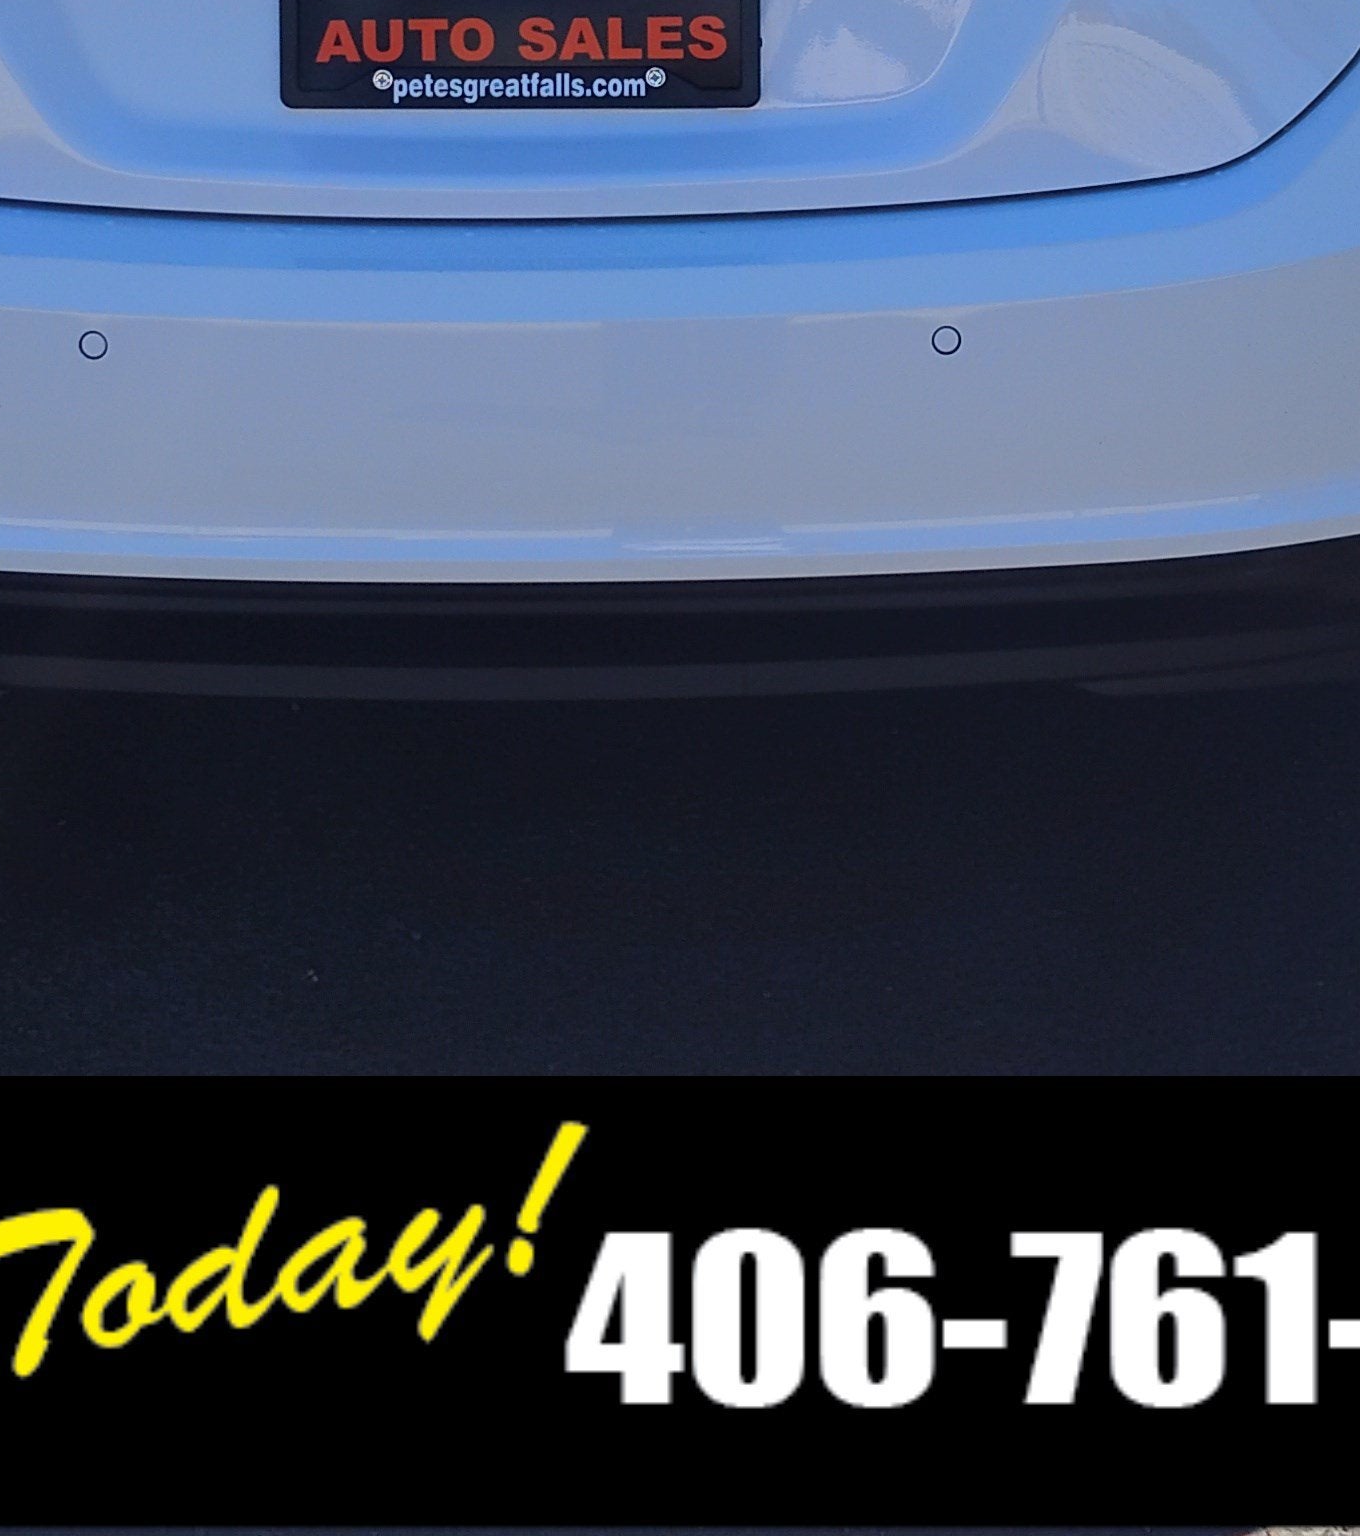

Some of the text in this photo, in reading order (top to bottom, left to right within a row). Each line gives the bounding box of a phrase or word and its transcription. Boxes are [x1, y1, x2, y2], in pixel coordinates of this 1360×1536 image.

[315, 15, 727, 63] AUTO SALES
[393, 72, 646, 103] petesgreatfalls.com
